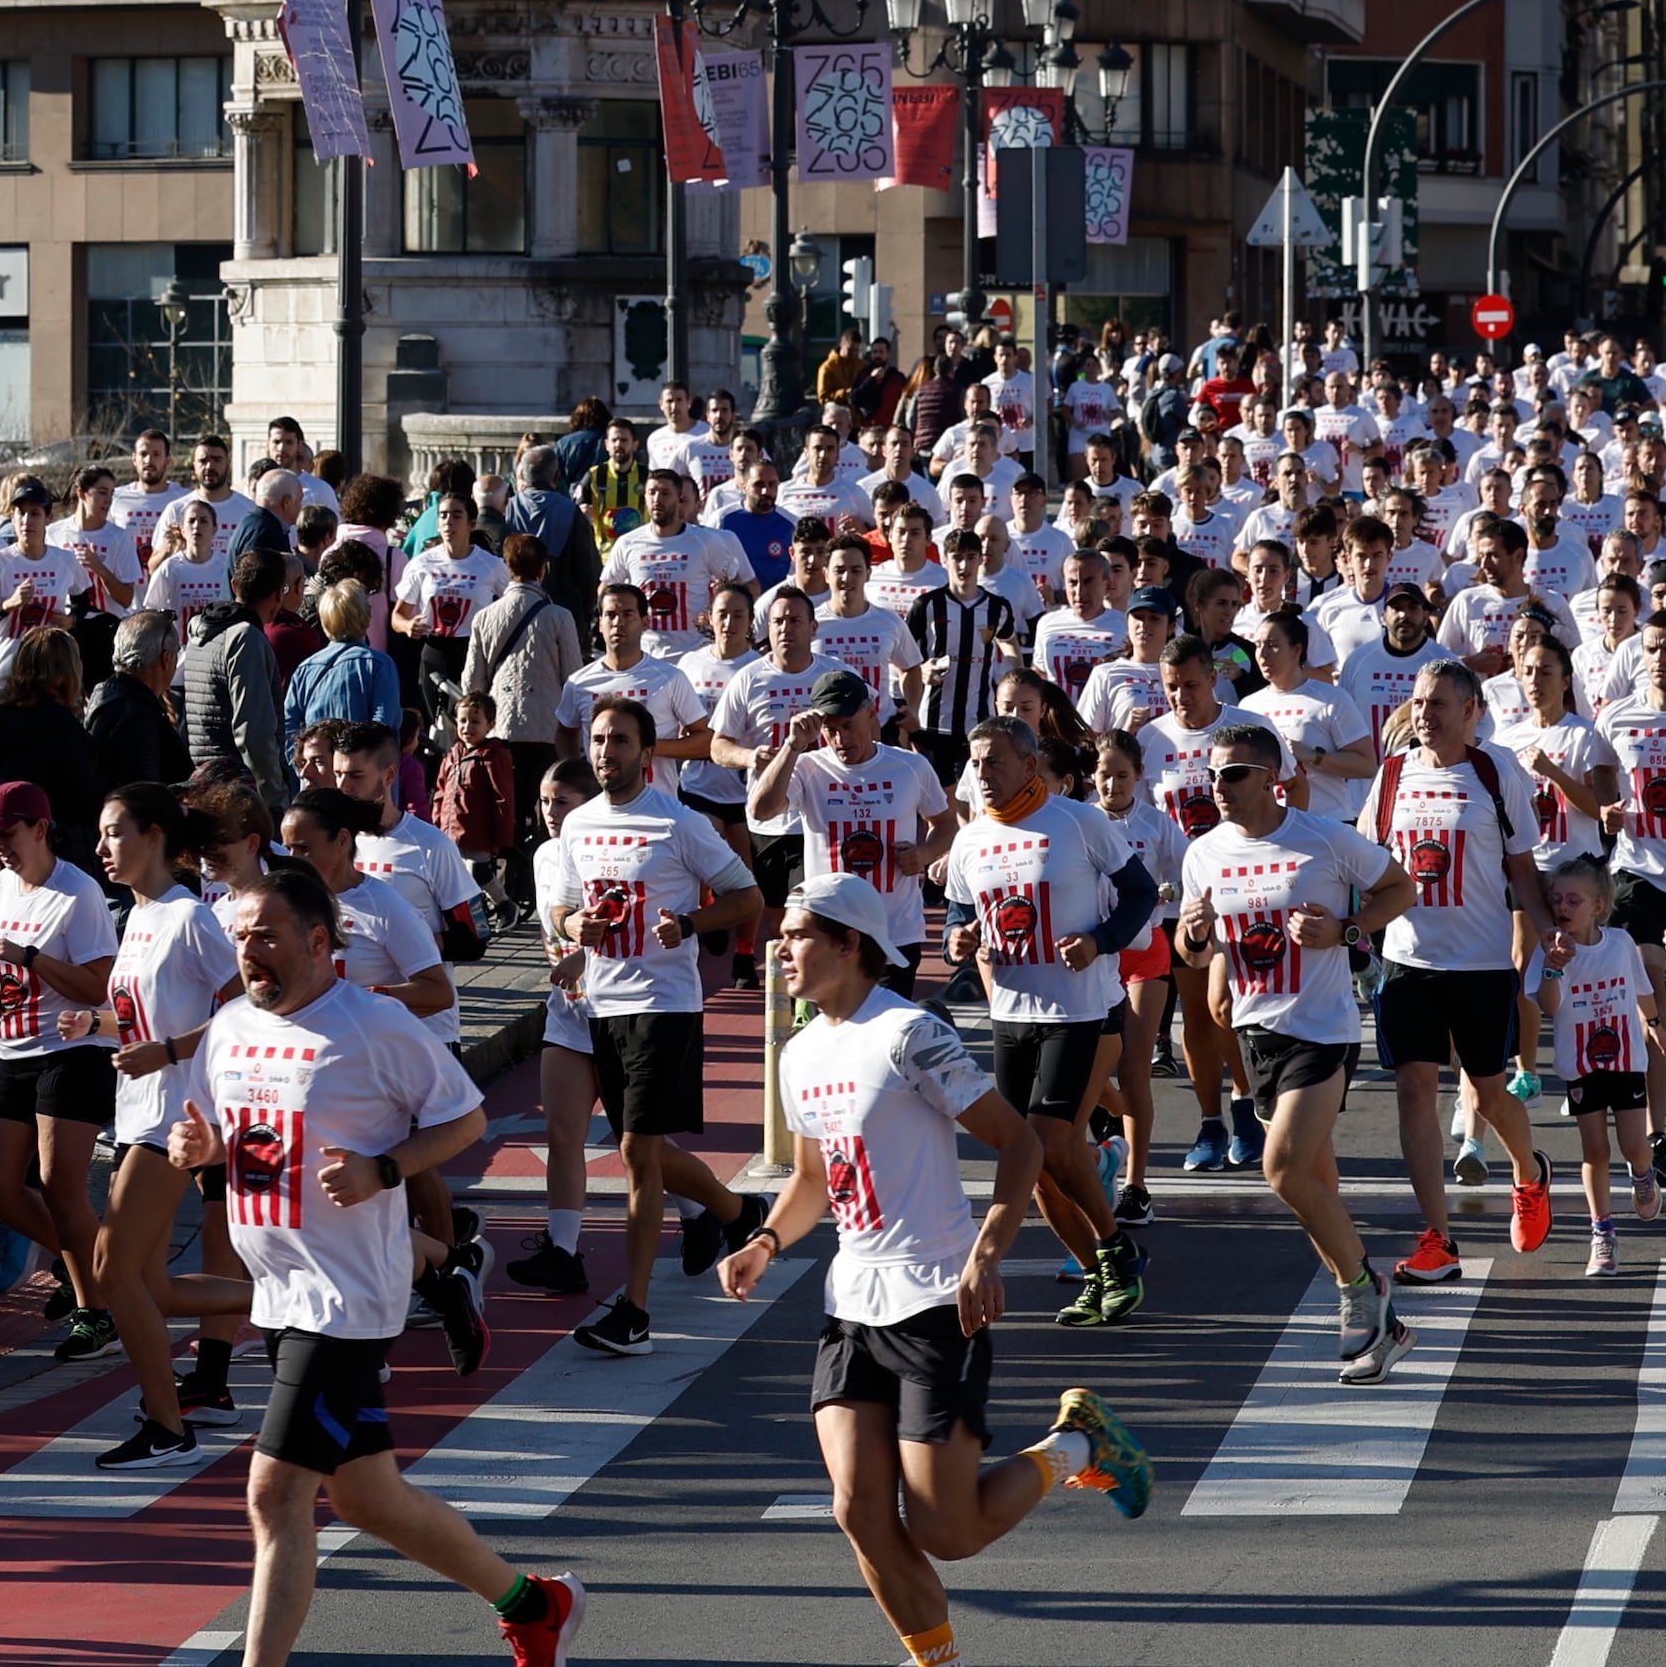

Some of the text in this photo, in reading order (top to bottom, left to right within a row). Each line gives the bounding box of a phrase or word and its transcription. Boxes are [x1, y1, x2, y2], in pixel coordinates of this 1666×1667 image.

[1343, 301, 1428, 337] KVAC
[852, 808, 872, 819] 132
[1415, 816, 1443, 827] 7875
[600, 864, 620, 876] 265
[1006, 871, 1019, 883] 33
[1247, 896, 1269, 909] 981
[246, 1087, 279, 1105] 3460
